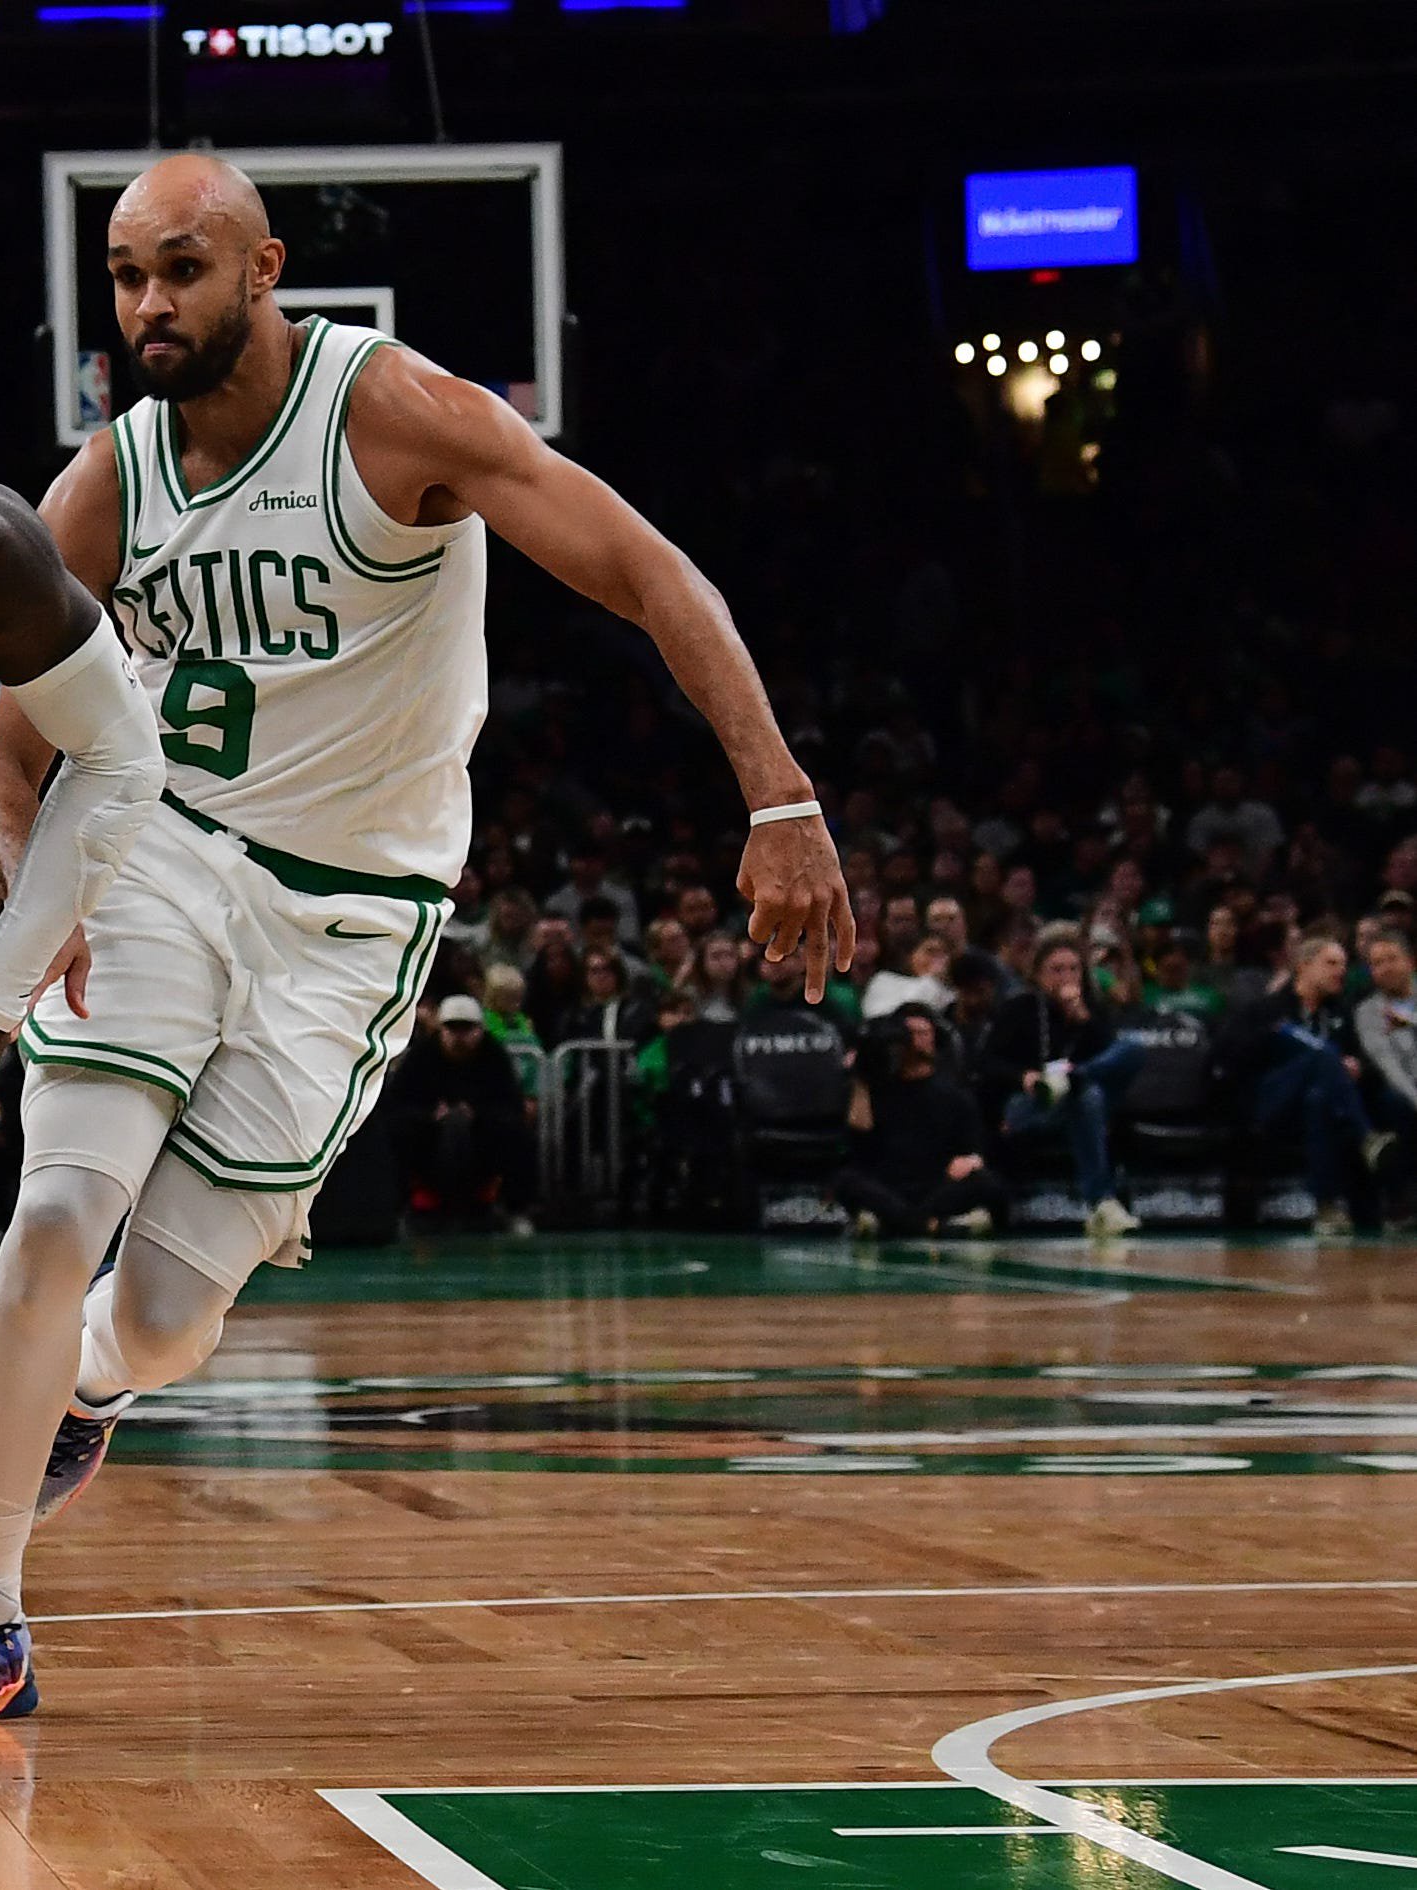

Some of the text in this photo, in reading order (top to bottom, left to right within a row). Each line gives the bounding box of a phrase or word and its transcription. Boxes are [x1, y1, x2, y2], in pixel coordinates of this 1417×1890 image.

[237, 22, 393, 57] TISSOT
[249, 490, 318, 511] Amica
[114, 549, 339, 660] CELTICS
[159, 659, 256, 781] 9
